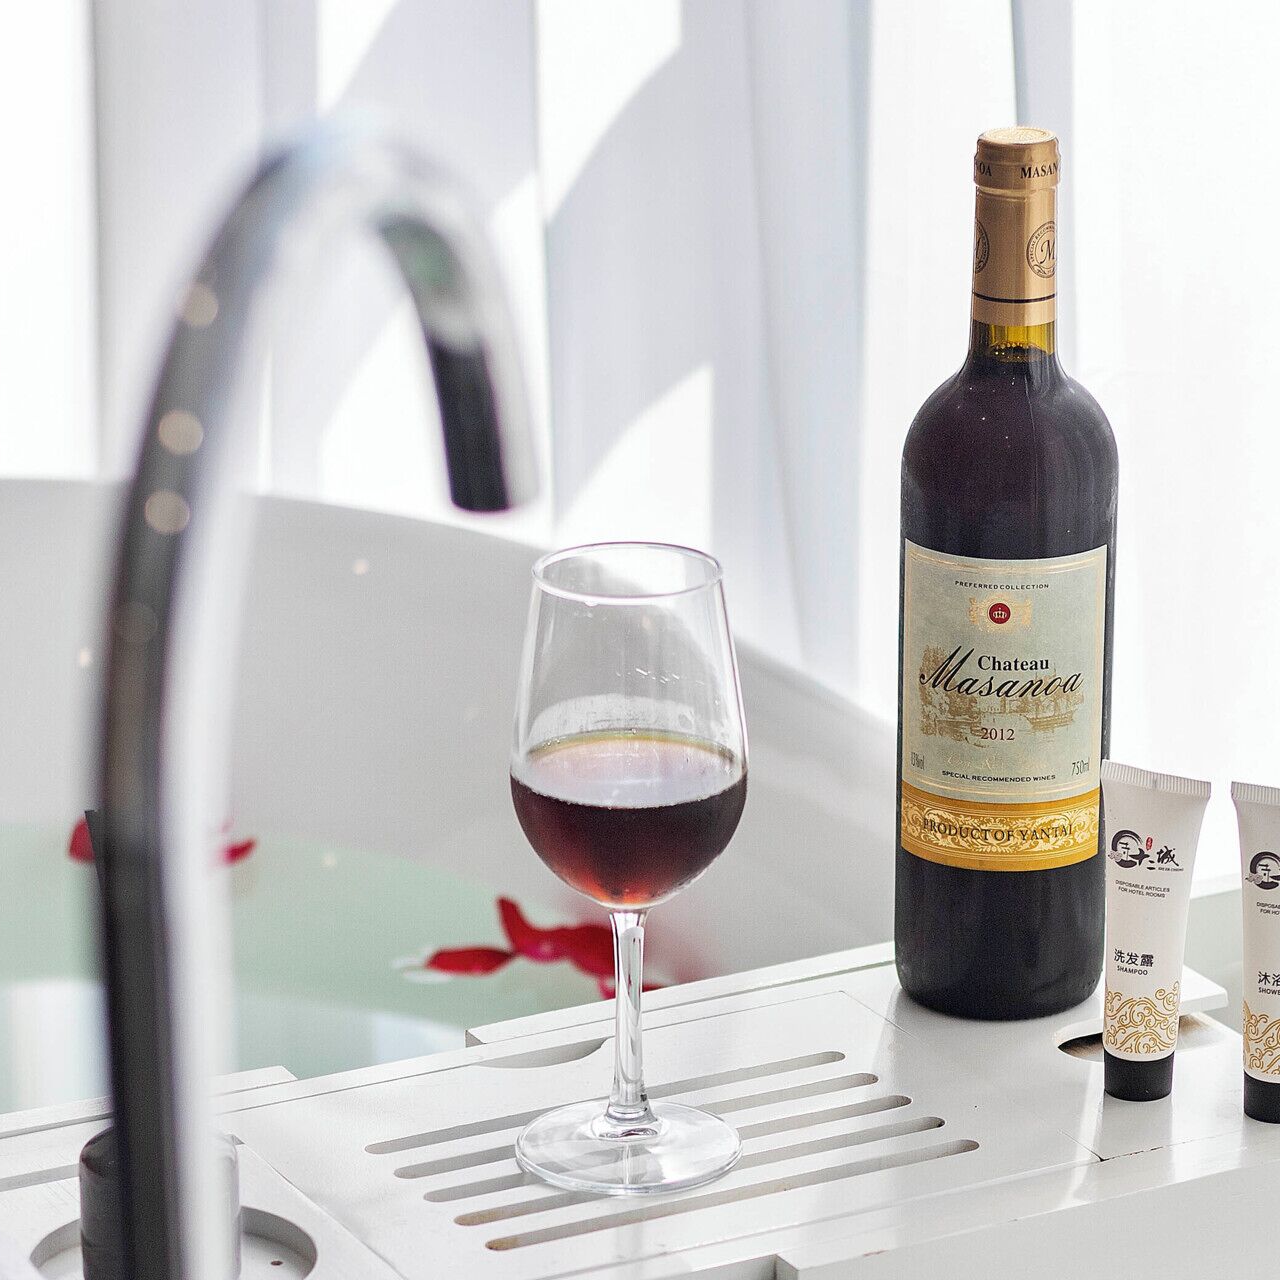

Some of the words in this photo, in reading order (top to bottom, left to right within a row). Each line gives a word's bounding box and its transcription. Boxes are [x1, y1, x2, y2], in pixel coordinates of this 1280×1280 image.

[977, 655, 1050, 671] Chateau
[919, 645, 1084, 698] Masanoa
[980, 727, 1015, 742] 2012
[941, 770, 971, 780] SPECIAL
[971, 774, 1032, 783] RECOMMENDED
[1032, 774, 1056, 782] WINES
[923, 818, 993, 841] PRODUCT
[993, 829, 1014, 841] OF
[1019, 823, 1073, 841] YANTAI
[1115, 880, 1144, 889] DISPOSABLE
[1145, 885, 1170, 893] ARTICLES
[1128, 888, 1145, 896] HOTEL
[1113, 948, 1154, 968] 洗发露
[1116, 965, 1149, 976] SHAMPOO
